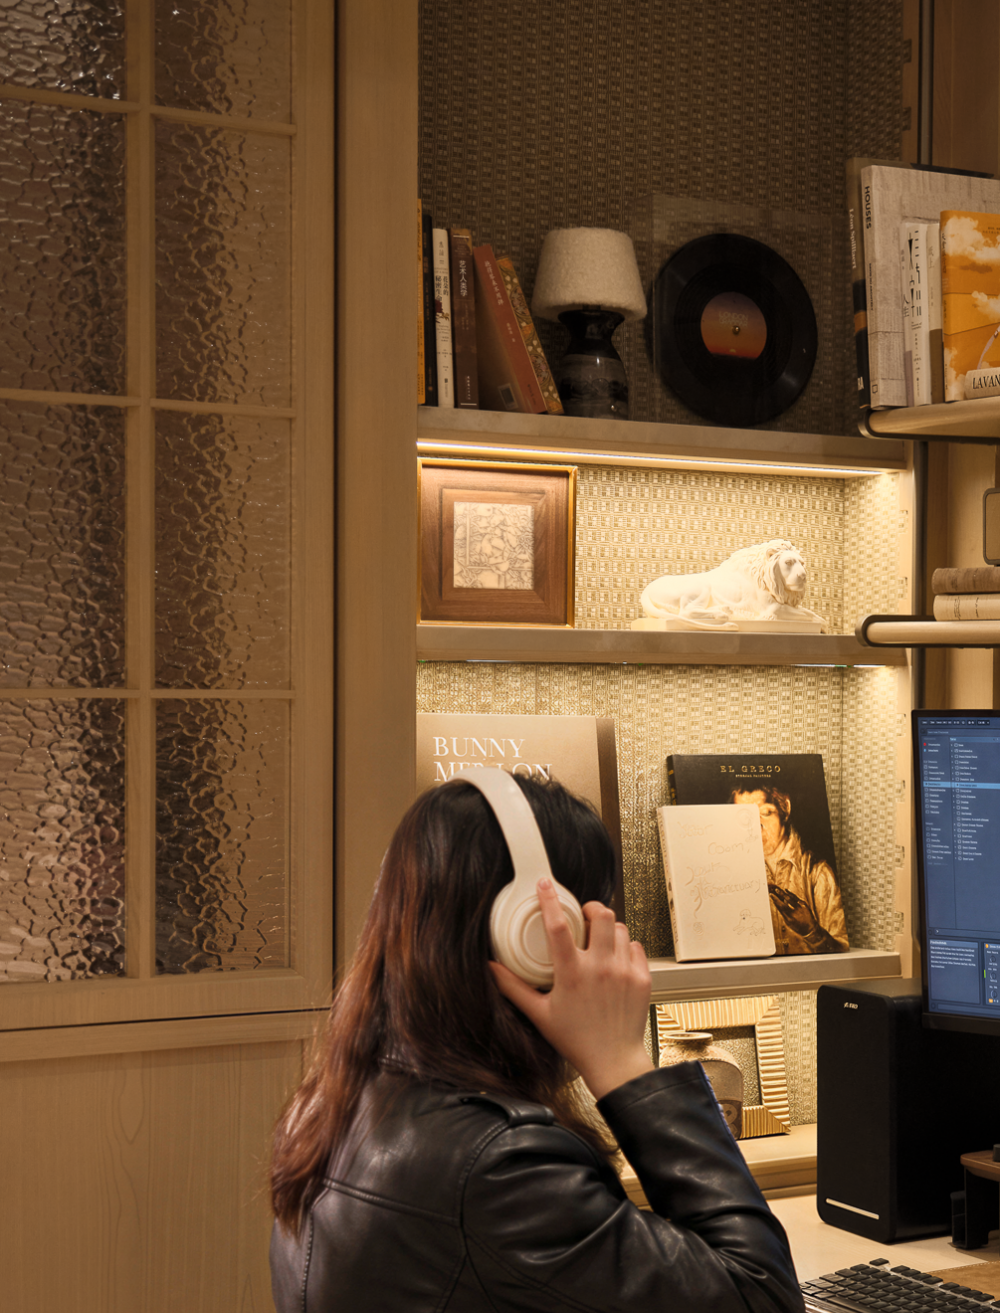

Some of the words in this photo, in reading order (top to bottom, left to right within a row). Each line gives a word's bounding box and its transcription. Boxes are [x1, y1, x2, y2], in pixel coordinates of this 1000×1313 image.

[864, 185, 872, 230] HOUSES
[459, 260, 468, 297] 艺术人类学
[432, 736, 526, 758] BUNNY
[720, 765, 735, 773] EL
[741, 765, 781, 773] GRECO
